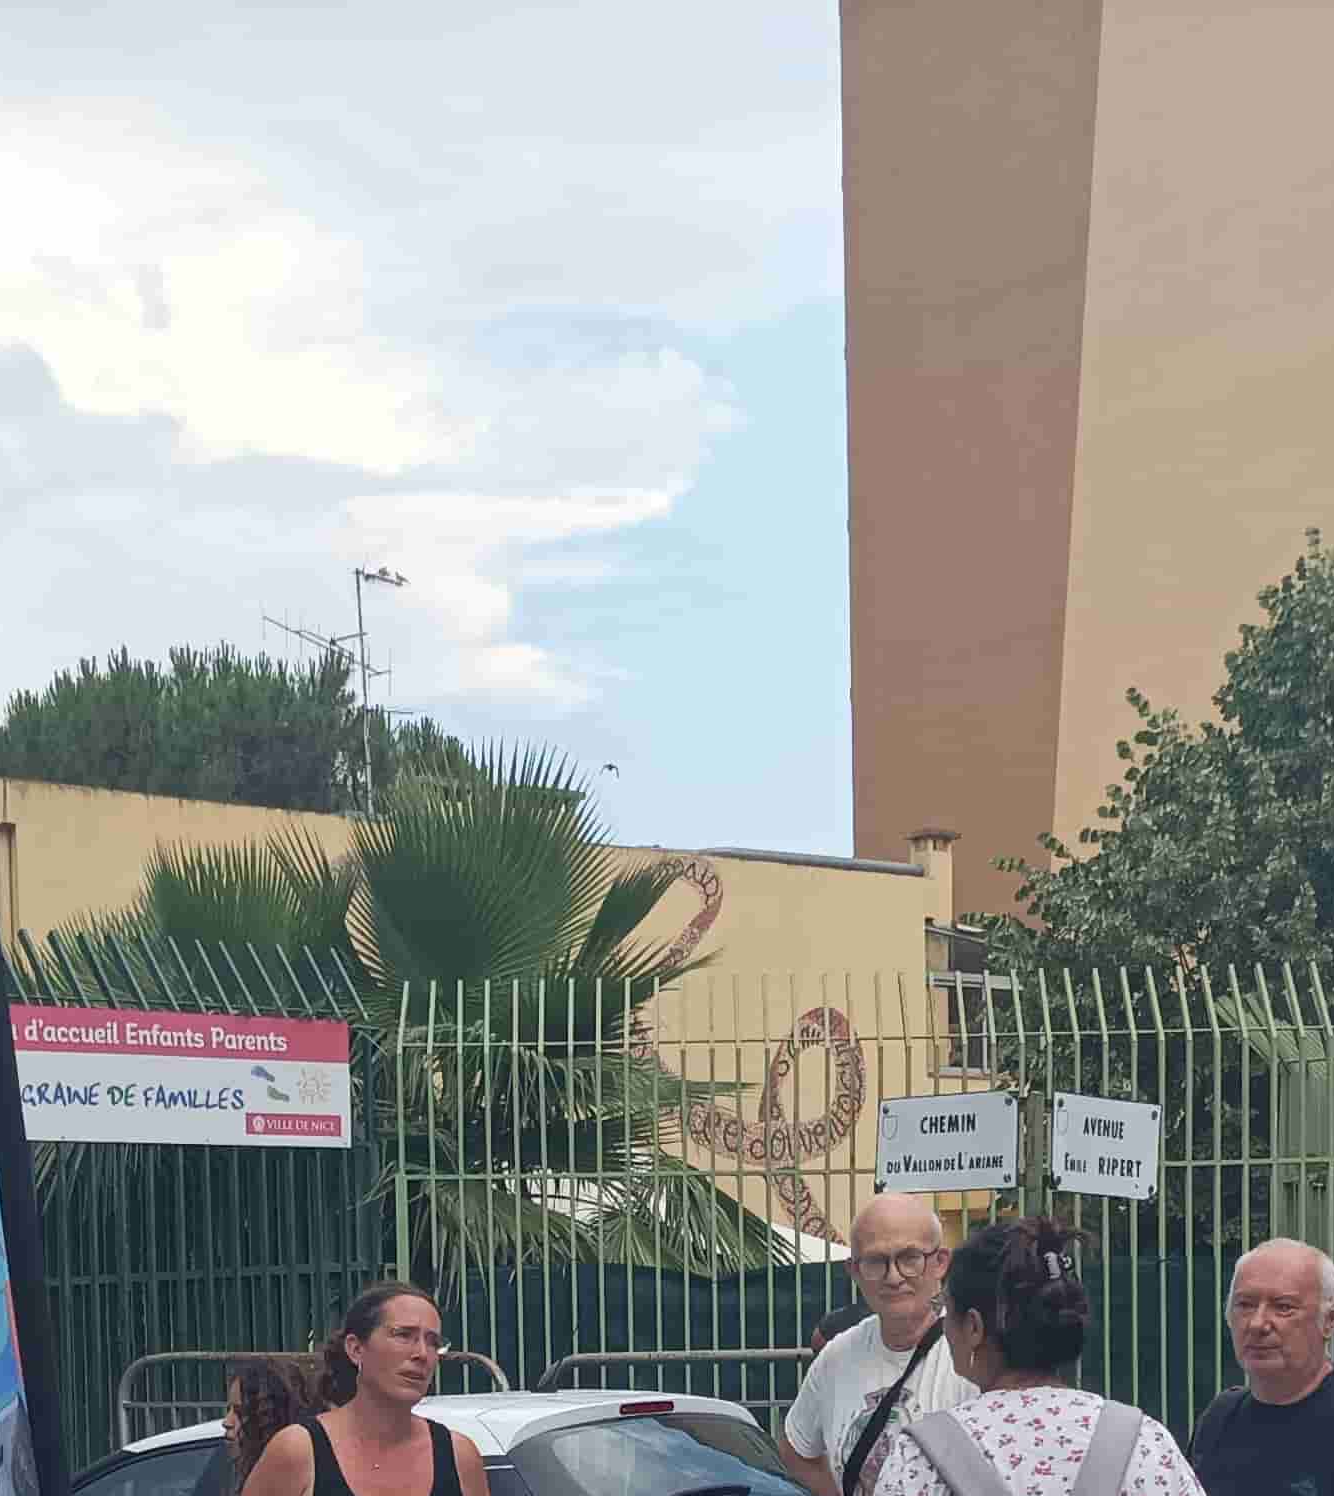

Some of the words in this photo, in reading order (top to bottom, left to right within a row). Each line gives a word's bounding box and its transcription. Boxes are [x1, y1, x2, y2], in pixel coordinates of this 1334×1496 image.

[24, 1018, 120, 1045] d'accueil
[126, 1022, 205, 1050] Enfants
[210, 1026, 288, 1053] Parents
[20, 1081, 101, 1108] GRAINE
[107, 1084, 139, 1108] DE
[143, 1085, 245, 1112] FAMILLES
[919, 1113, 977, 1135] CHEMIN
[1083, 1116, 1125, 1140] AVENUE
[1098, 1156, 1142, 1178] RIPERT
